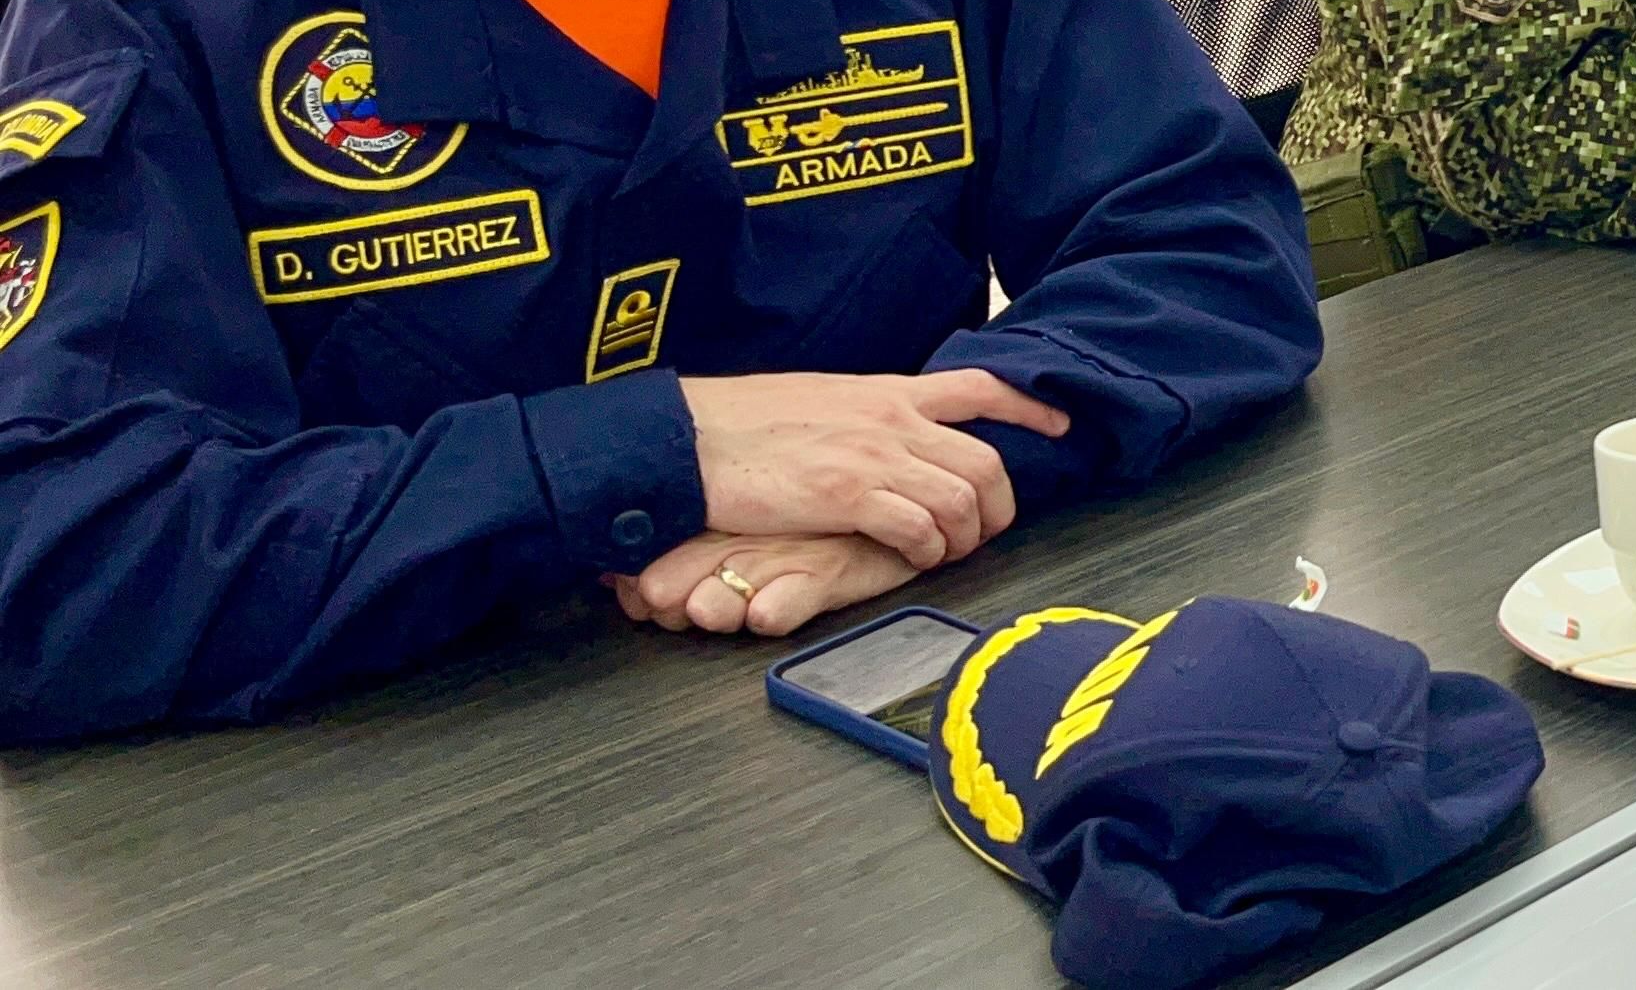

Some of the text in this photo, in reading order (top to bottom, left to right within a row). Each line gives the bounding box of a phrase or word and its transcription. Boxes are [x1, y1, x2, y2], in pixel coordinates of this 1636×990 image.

[775, 140, 933, 190] ARMADA
[275, 216, 521, 283] D. GUTIERREZ
